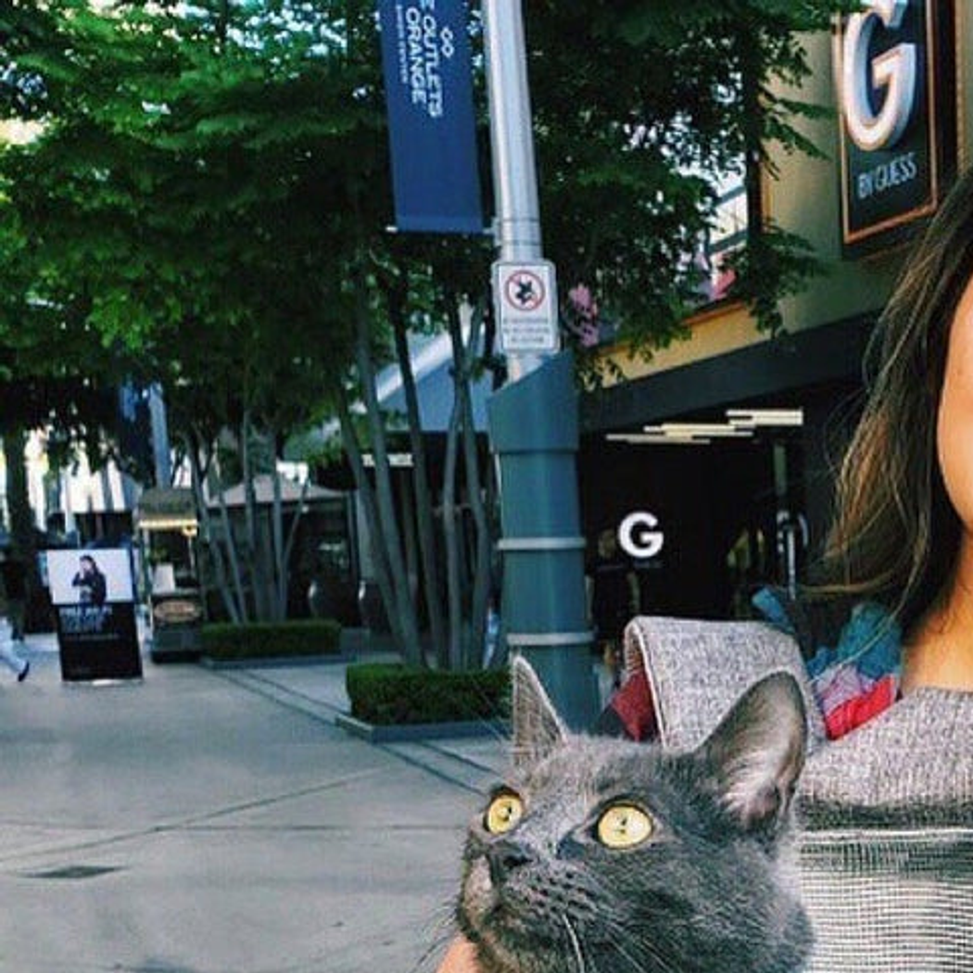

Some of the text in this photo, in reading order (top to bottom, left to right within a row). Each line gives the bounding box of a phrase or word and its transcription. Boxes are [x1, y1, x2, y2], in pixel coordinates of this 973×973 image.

[406, 7, 427, 104] ORANGE
[423, 15, 442, 118] OUTLETS
[842, 0, 917, 151] G
[875, 152, 918, 192] GUESS
[618, 511, 664, 558] G
